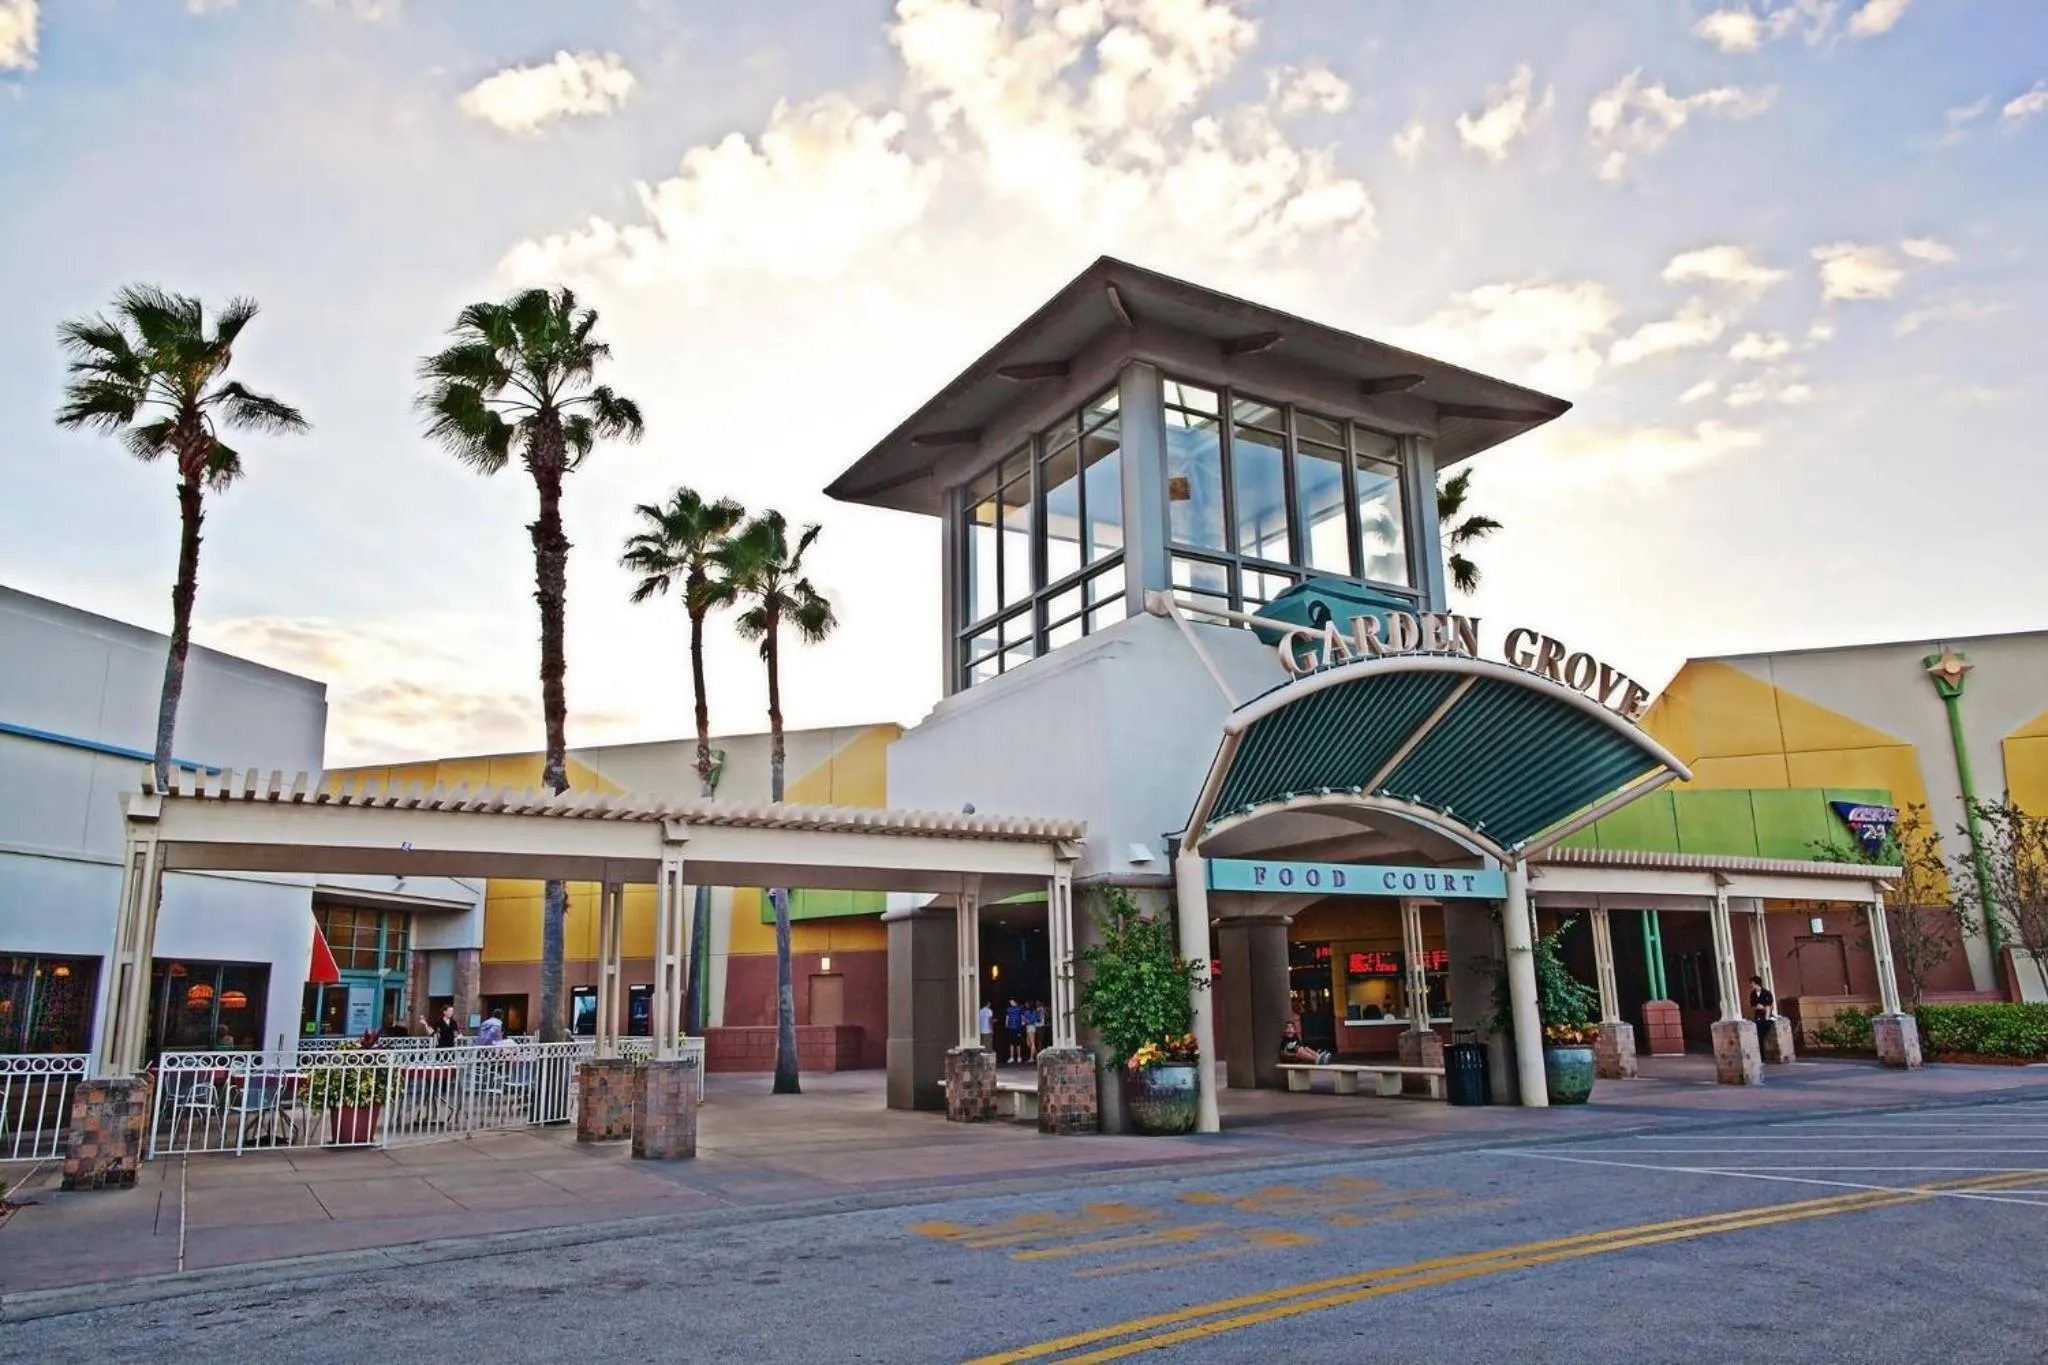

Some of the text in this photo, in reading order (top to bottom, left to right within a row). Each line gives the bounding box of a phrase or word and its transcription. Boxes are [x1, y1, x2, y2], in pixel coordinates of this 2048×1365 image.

[1279, 612, 1650, 719] GARDEN GROVE
[1253, 866, 1475, 892] FOOD COURT
